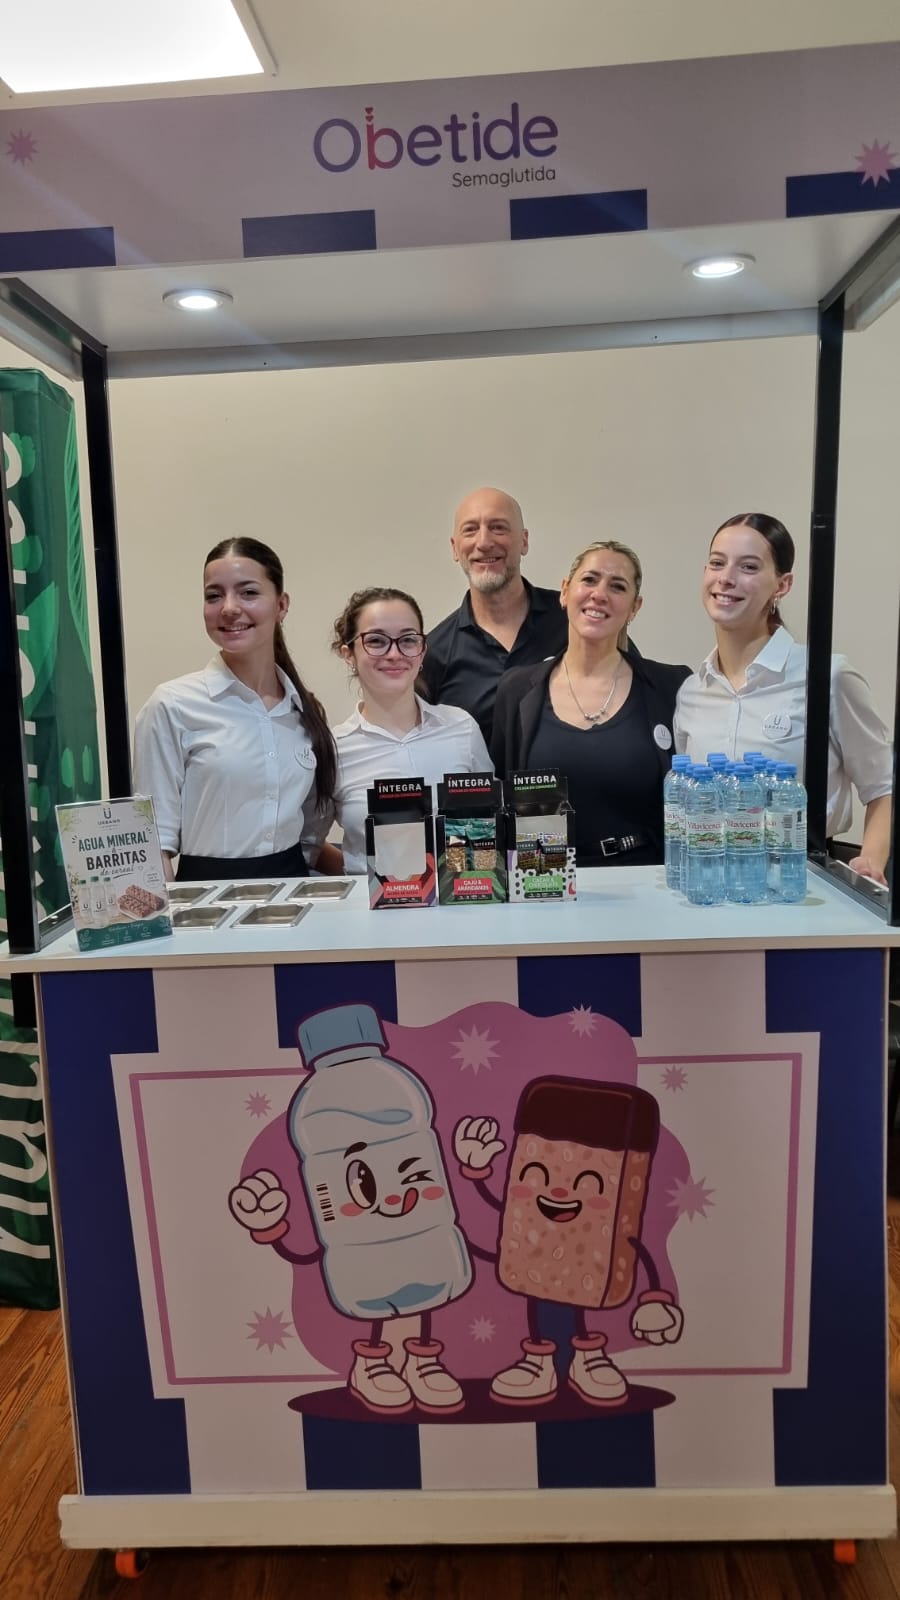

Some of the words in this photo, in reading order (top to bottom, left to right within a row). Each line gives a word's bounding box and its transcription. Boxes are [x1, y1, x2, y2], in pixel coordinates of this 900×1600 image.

[313, 102, 558, 173] Obetide
[451, 165, 556, 188] Semaglutida
[78, 836, 105, 852] AGUA
[107, 831, 149, 849] MINERAL
[86, 850, 147, 870] BARRITAS
